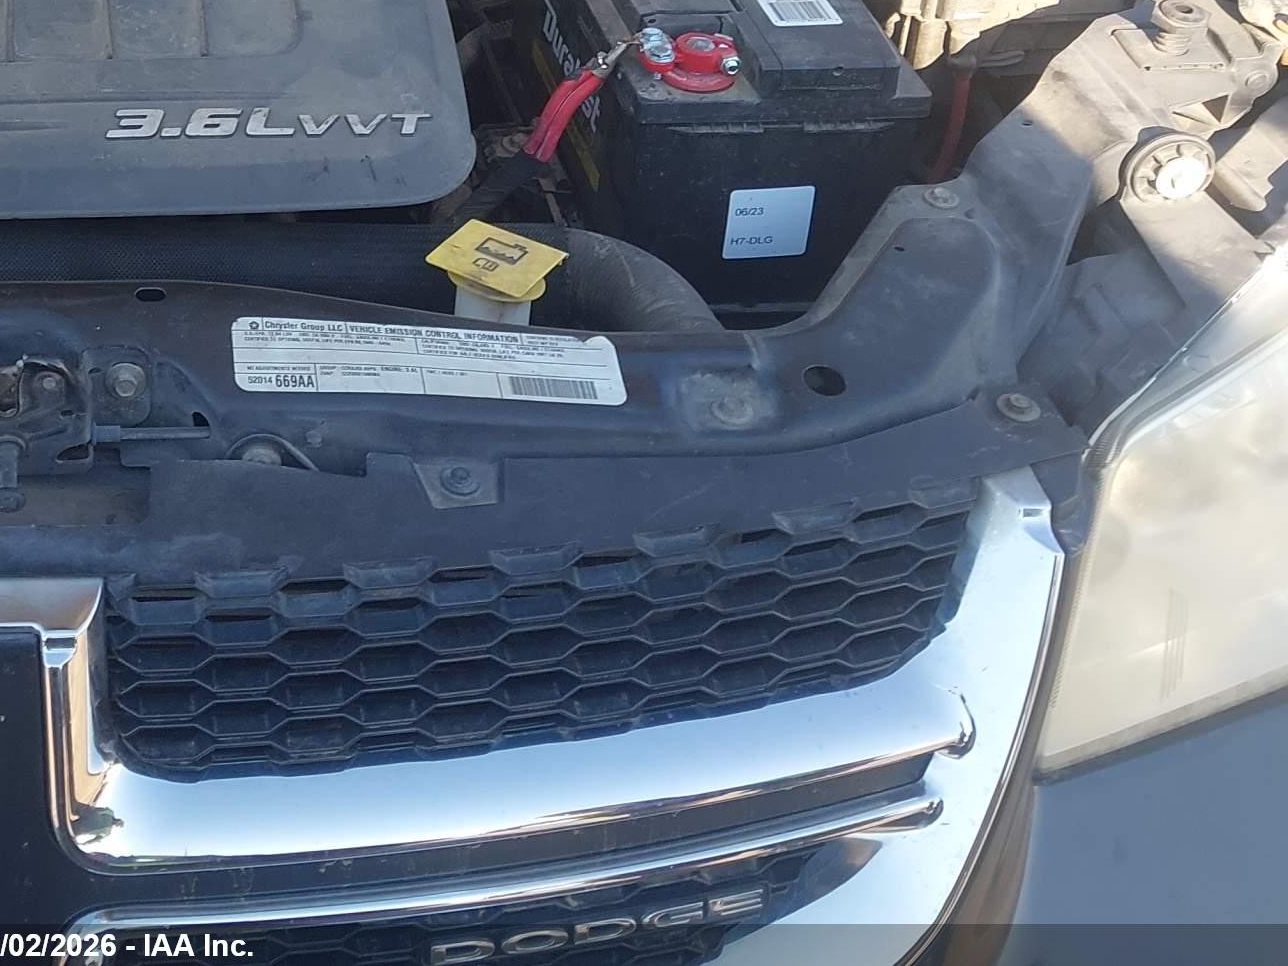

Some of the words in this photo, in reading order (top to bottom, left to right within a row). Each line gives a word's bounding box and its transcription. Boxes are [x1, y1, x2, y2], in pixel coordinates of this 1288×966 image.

[734, 207, 764, 217] 06/23
[730, 236, 774, 245] H7-DLG
[264, 321, 298, 332] Chrysler
[300, 322, 325, 333] Group
[327, 324, 343, 332] LLC
[349, 325, 383, 334] VEHICLE
[384, 327, 423, 336] EMISSION
[425, 329, 463, 340] CONTROL
[464, 332, 519, 343] INFORMATION
[275, 374, 315, 388] 669AA
[430, 888, 764, 965] DODGE
